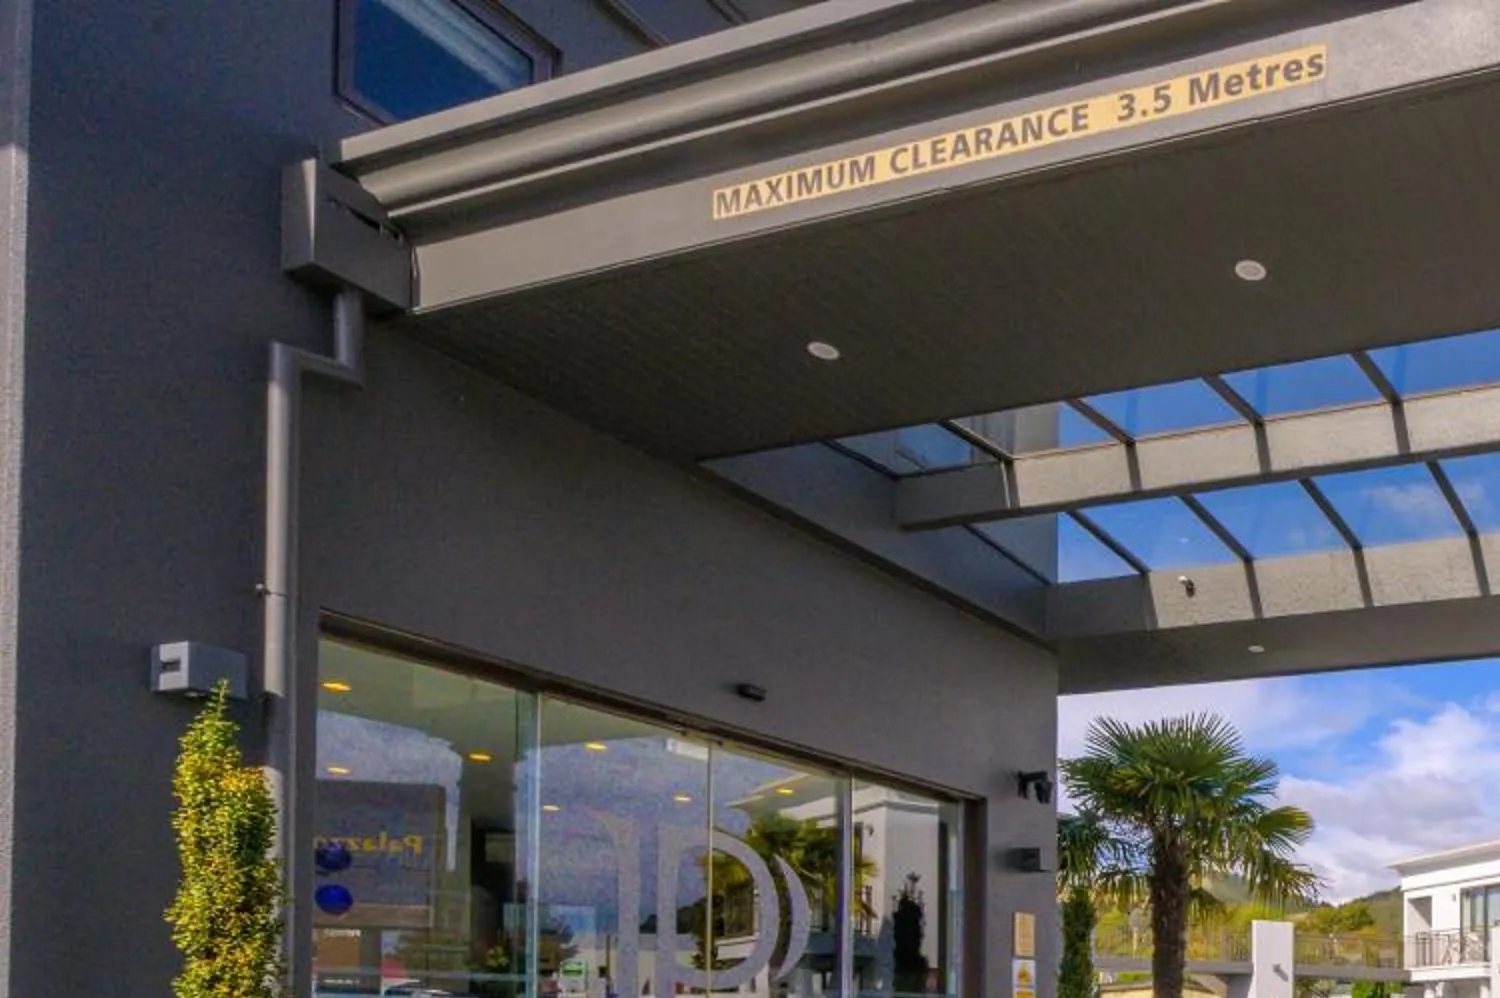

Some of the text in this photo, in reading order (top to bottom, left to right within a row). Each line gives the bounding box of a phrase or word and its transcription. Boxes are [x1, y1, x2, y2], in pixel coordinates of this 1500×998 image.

[716, 53, 1325, 217] MAXIMUM CLEARANCE 3.5 Metres
